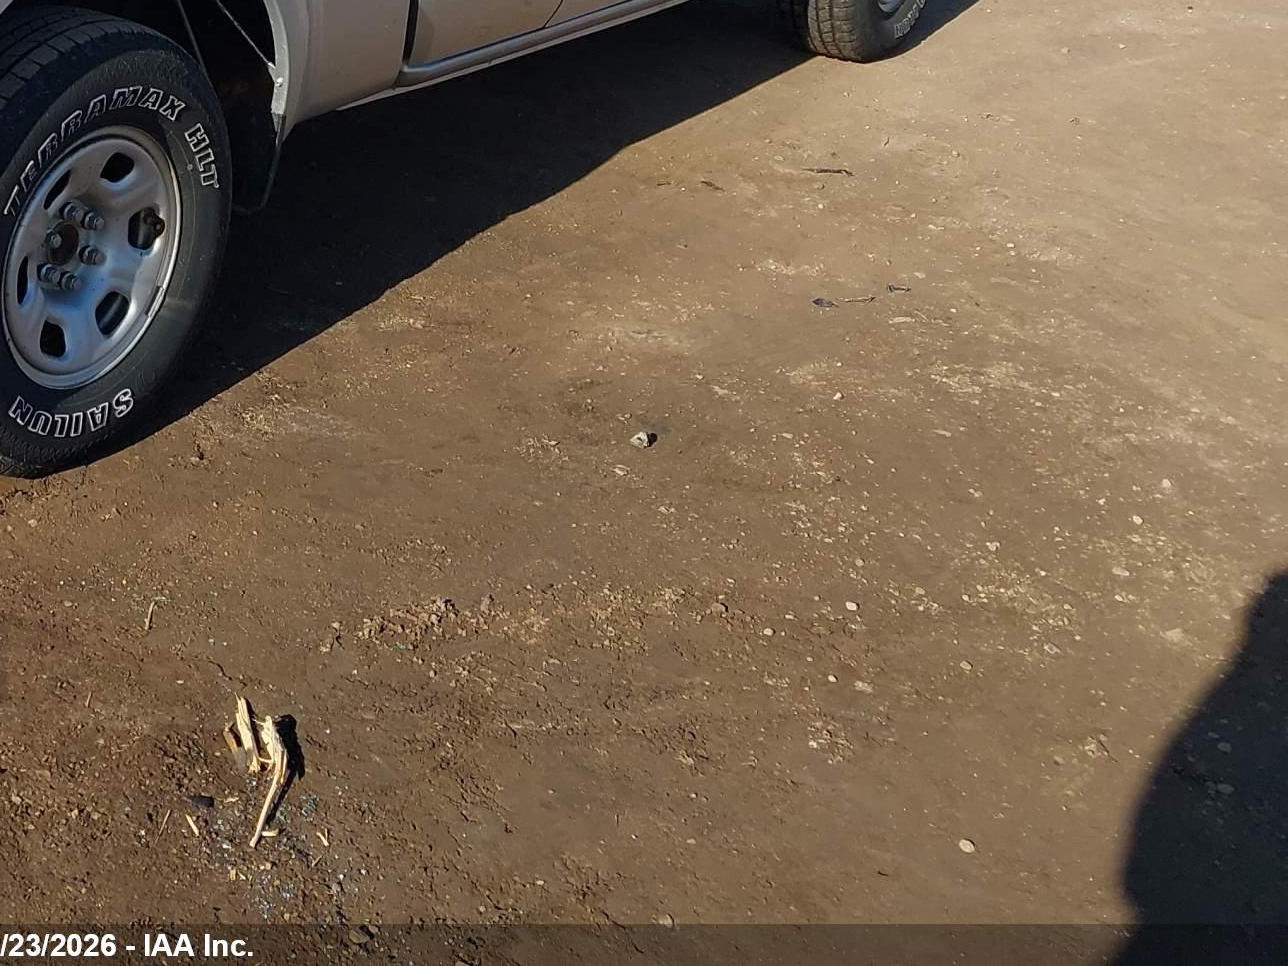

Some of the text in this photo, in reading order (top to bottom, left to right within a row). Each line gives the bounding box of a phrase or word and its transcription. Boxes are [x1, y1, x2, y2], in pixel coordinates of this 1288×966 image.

[3, 84, 220, 219] TERRAMAX HLT
[8, 387, 135, 438] SAILUN
